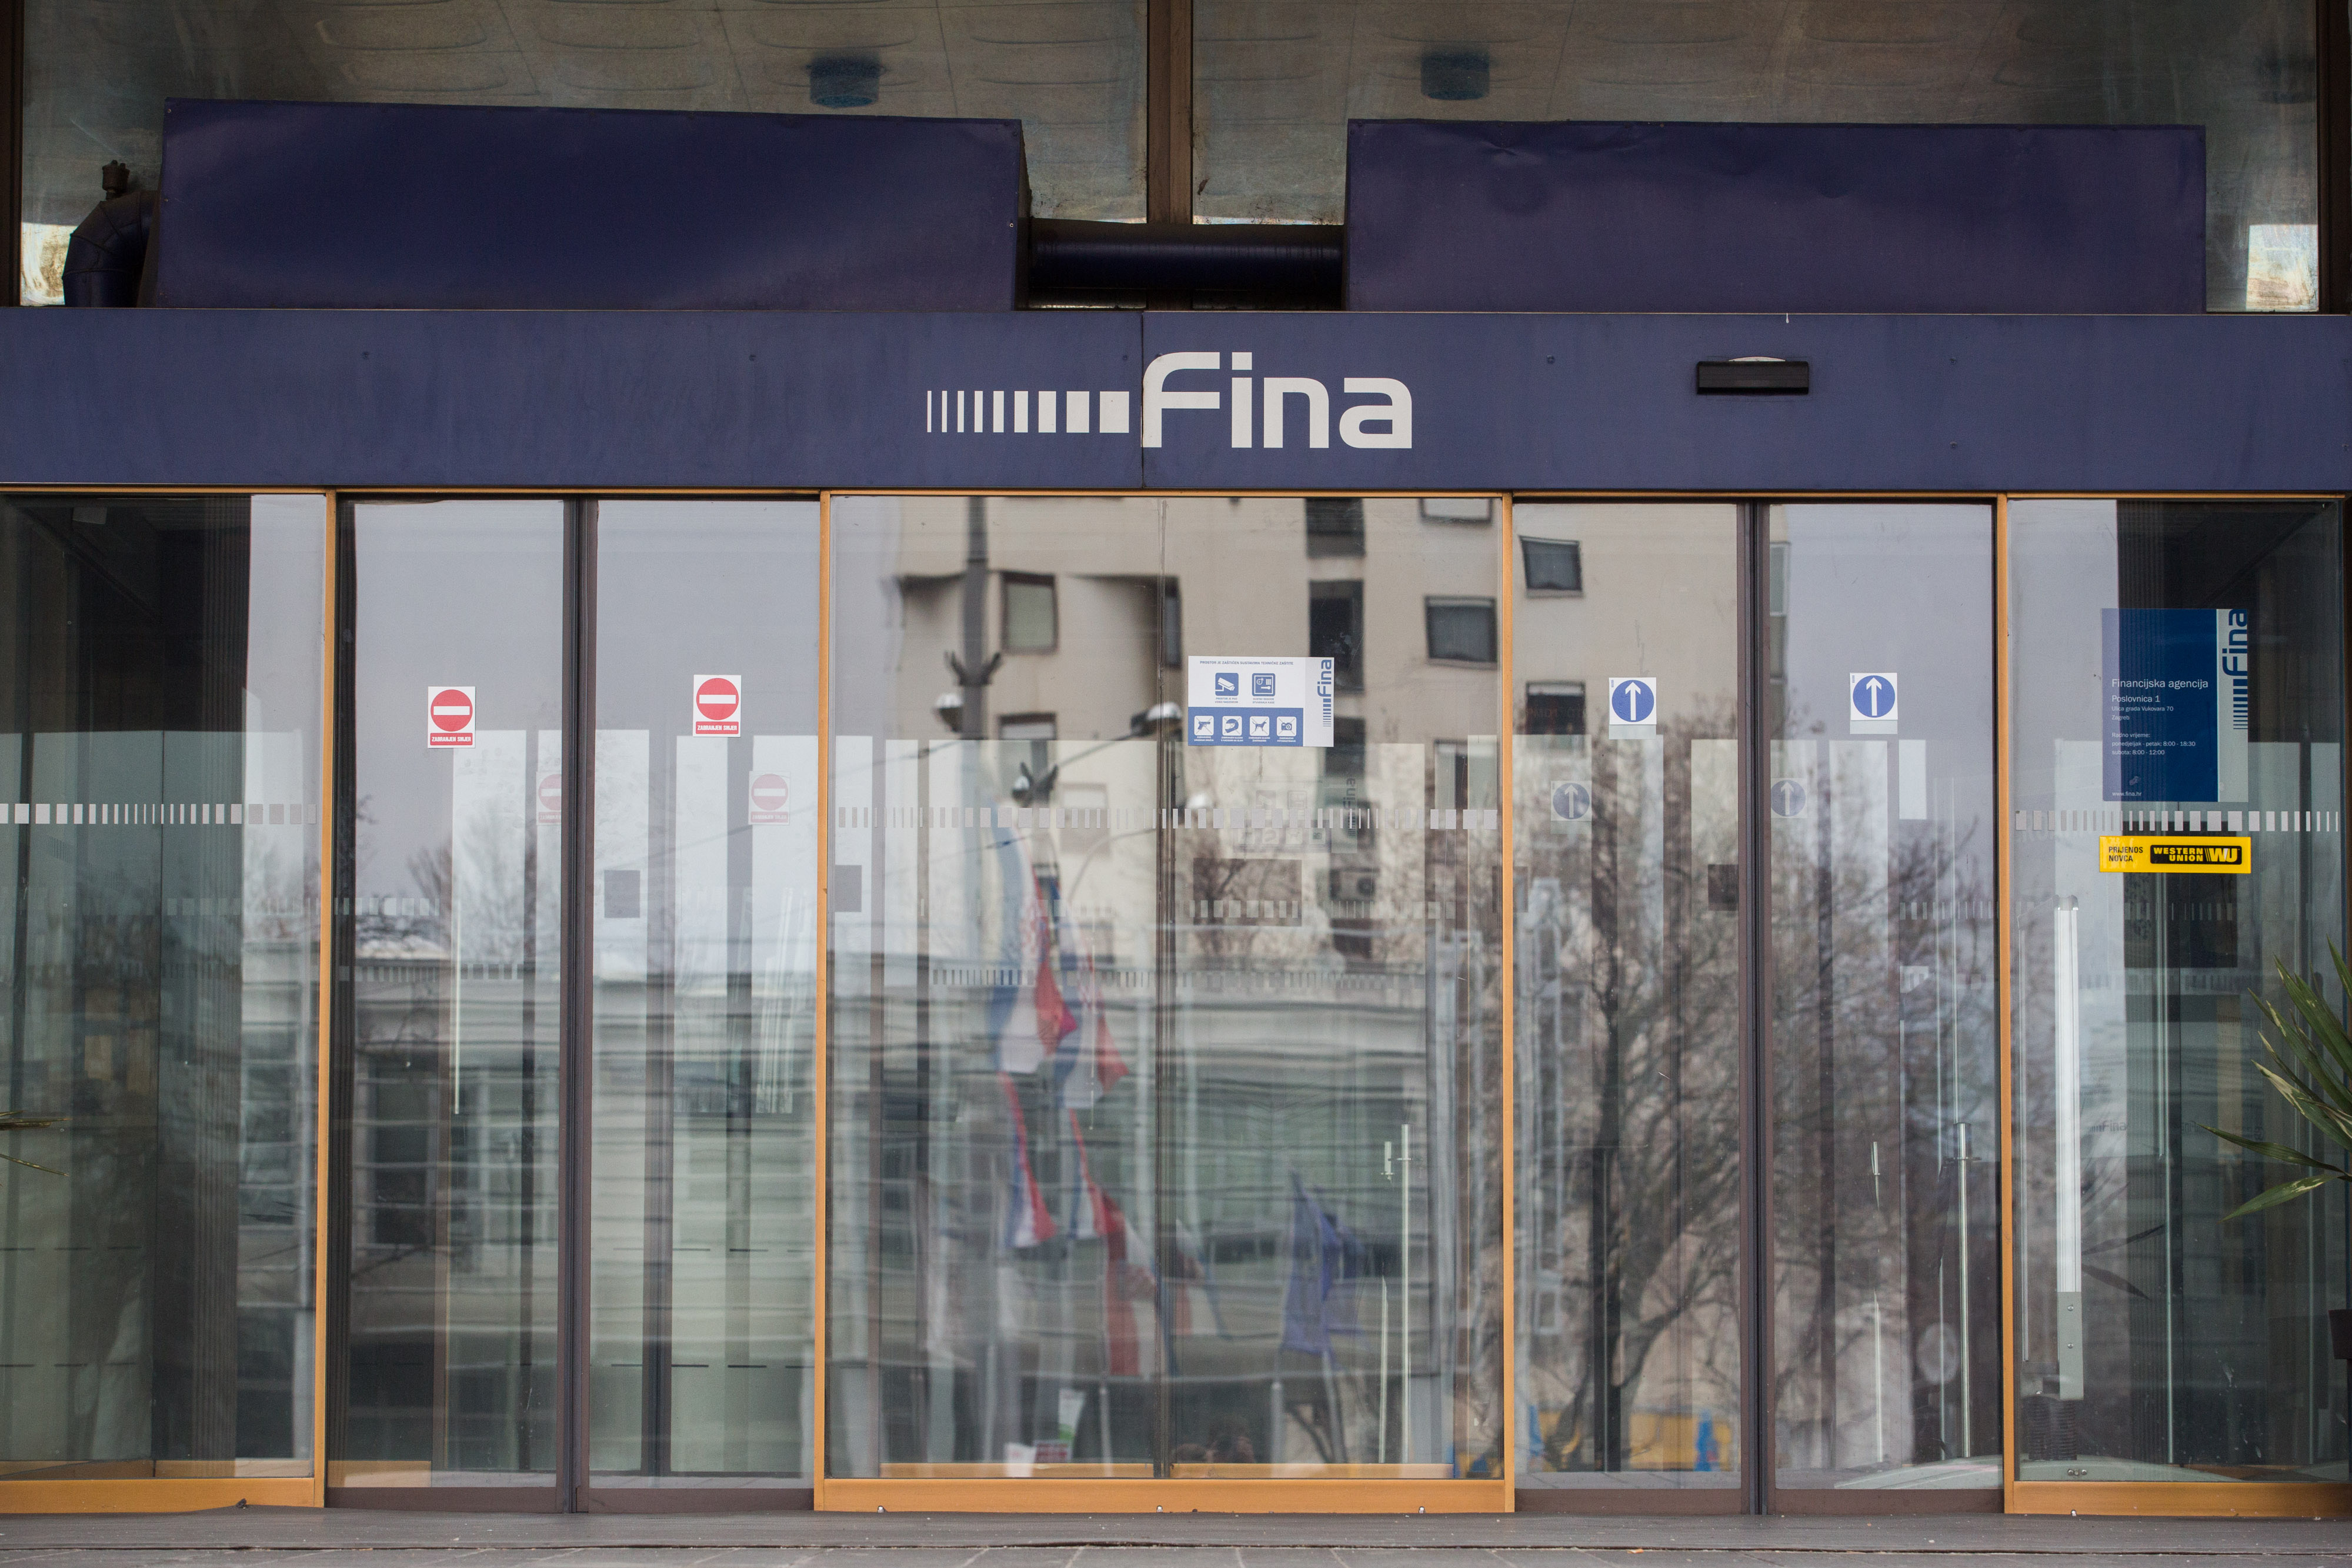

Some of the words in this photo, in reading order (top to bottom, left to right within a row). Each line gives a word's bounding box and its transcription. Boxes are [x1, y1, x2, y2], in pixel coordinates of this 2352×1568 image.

[2111, 679, 2166, 689] Financijska
[2168, 679, 2208, 690] agencija
[2153, 847, 2204, 855] WESTERN
[2208, 848, 2238, 862] WU
